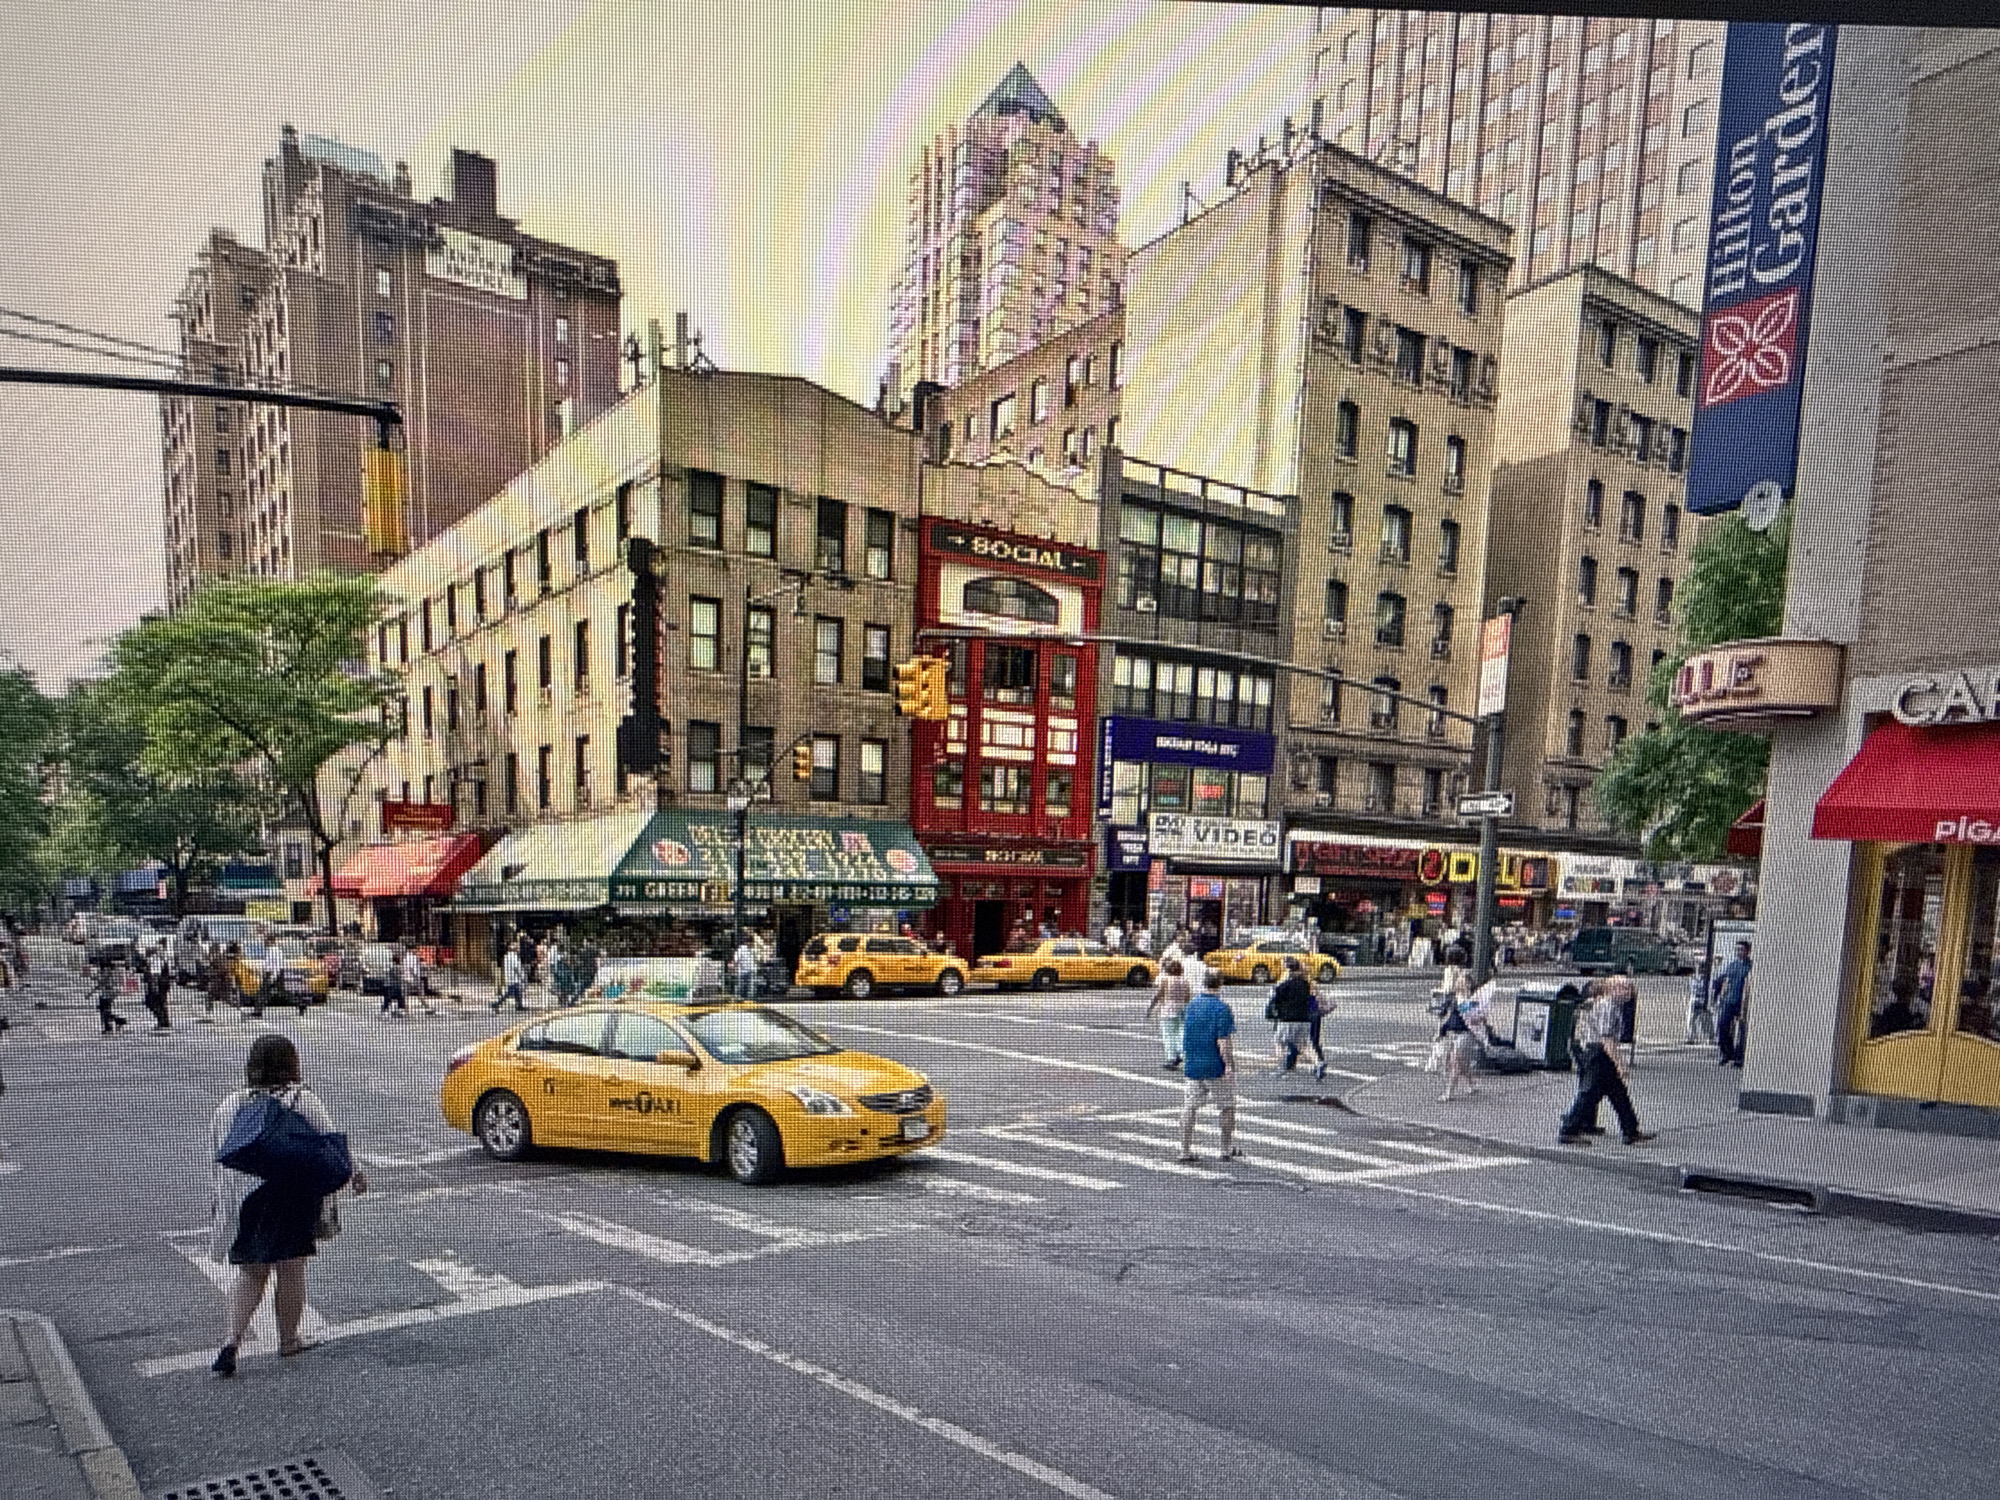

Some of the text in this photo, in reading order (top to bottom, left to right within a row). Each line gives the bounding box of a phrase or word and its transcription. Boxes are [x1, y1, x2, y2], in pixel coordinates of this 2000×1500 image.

[1753, 23, 1825, 283] Garden
[1710, 132, 1758, 301] Hilton
[971, 536, 1067, 570] SOCIAL
[1194, 827, 1277, 847] VIDEO
[643, 881, 699, 898] GREEN
